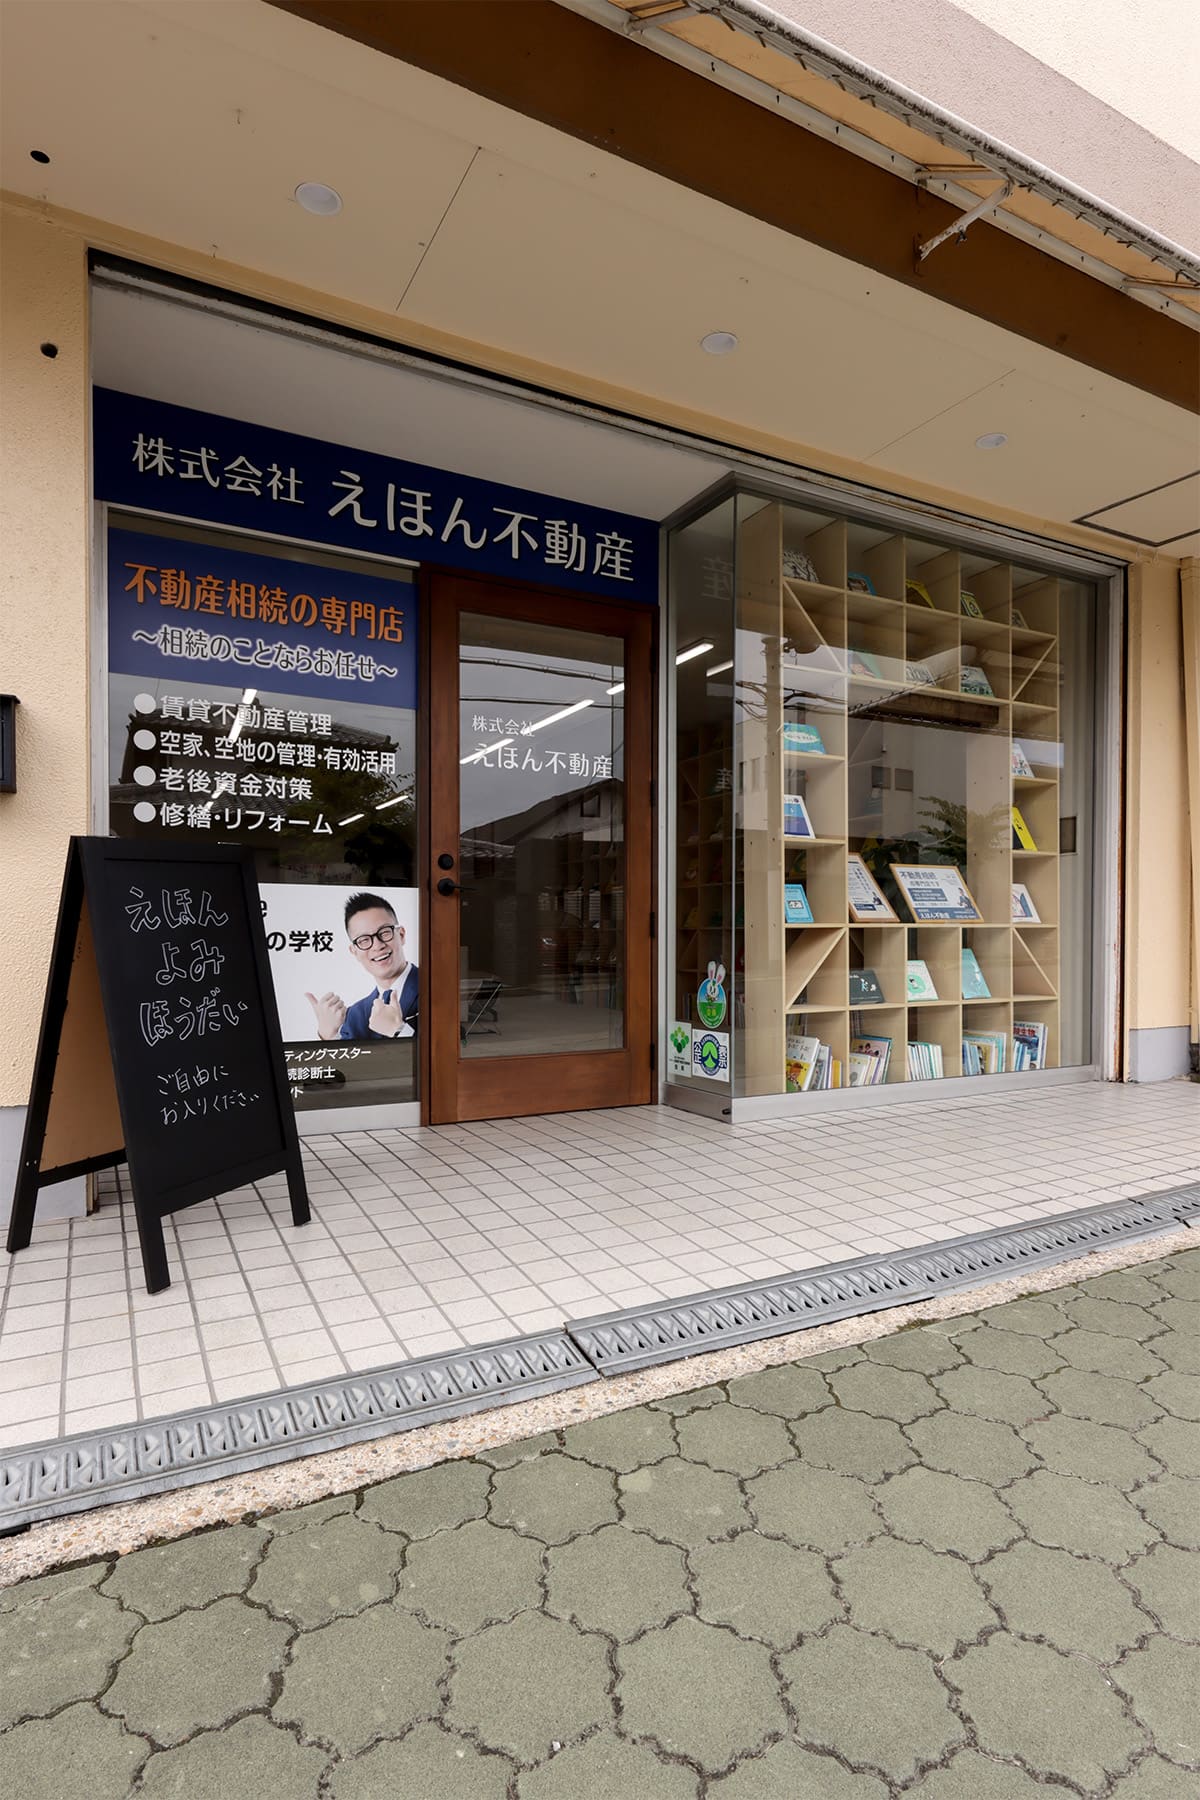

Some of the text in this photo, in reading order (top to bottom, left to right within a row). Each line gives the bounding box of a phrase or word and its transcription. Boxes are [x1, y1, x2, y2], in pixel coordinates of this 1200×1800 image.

[131, 433, 635, 581] 株式会社 えほん不動産
[124, 562, 405, 643] 不動産相続の専門店
[160, 695, 333, 736] 賃貸不動産管理
[471, 715, 536, 738] 株式会社
[473, 742, 614, 779] えほん不動産
[159, 767, 314, 801] 老後資金対策
[160, 802, 334, 835] 修繕・リフォーム
[124, 886, 229, 933] えほん
[266, 930, 334, 953] の学校
[155, 939, 226, 986] よみ
[139, 987, 249, 1047] ほうだい
[284, 1047, 372, 1062] ティングマスター
[157, 1064, 230, 1096] ご自由に
[160, 1089, 261, 1126] お入りください
